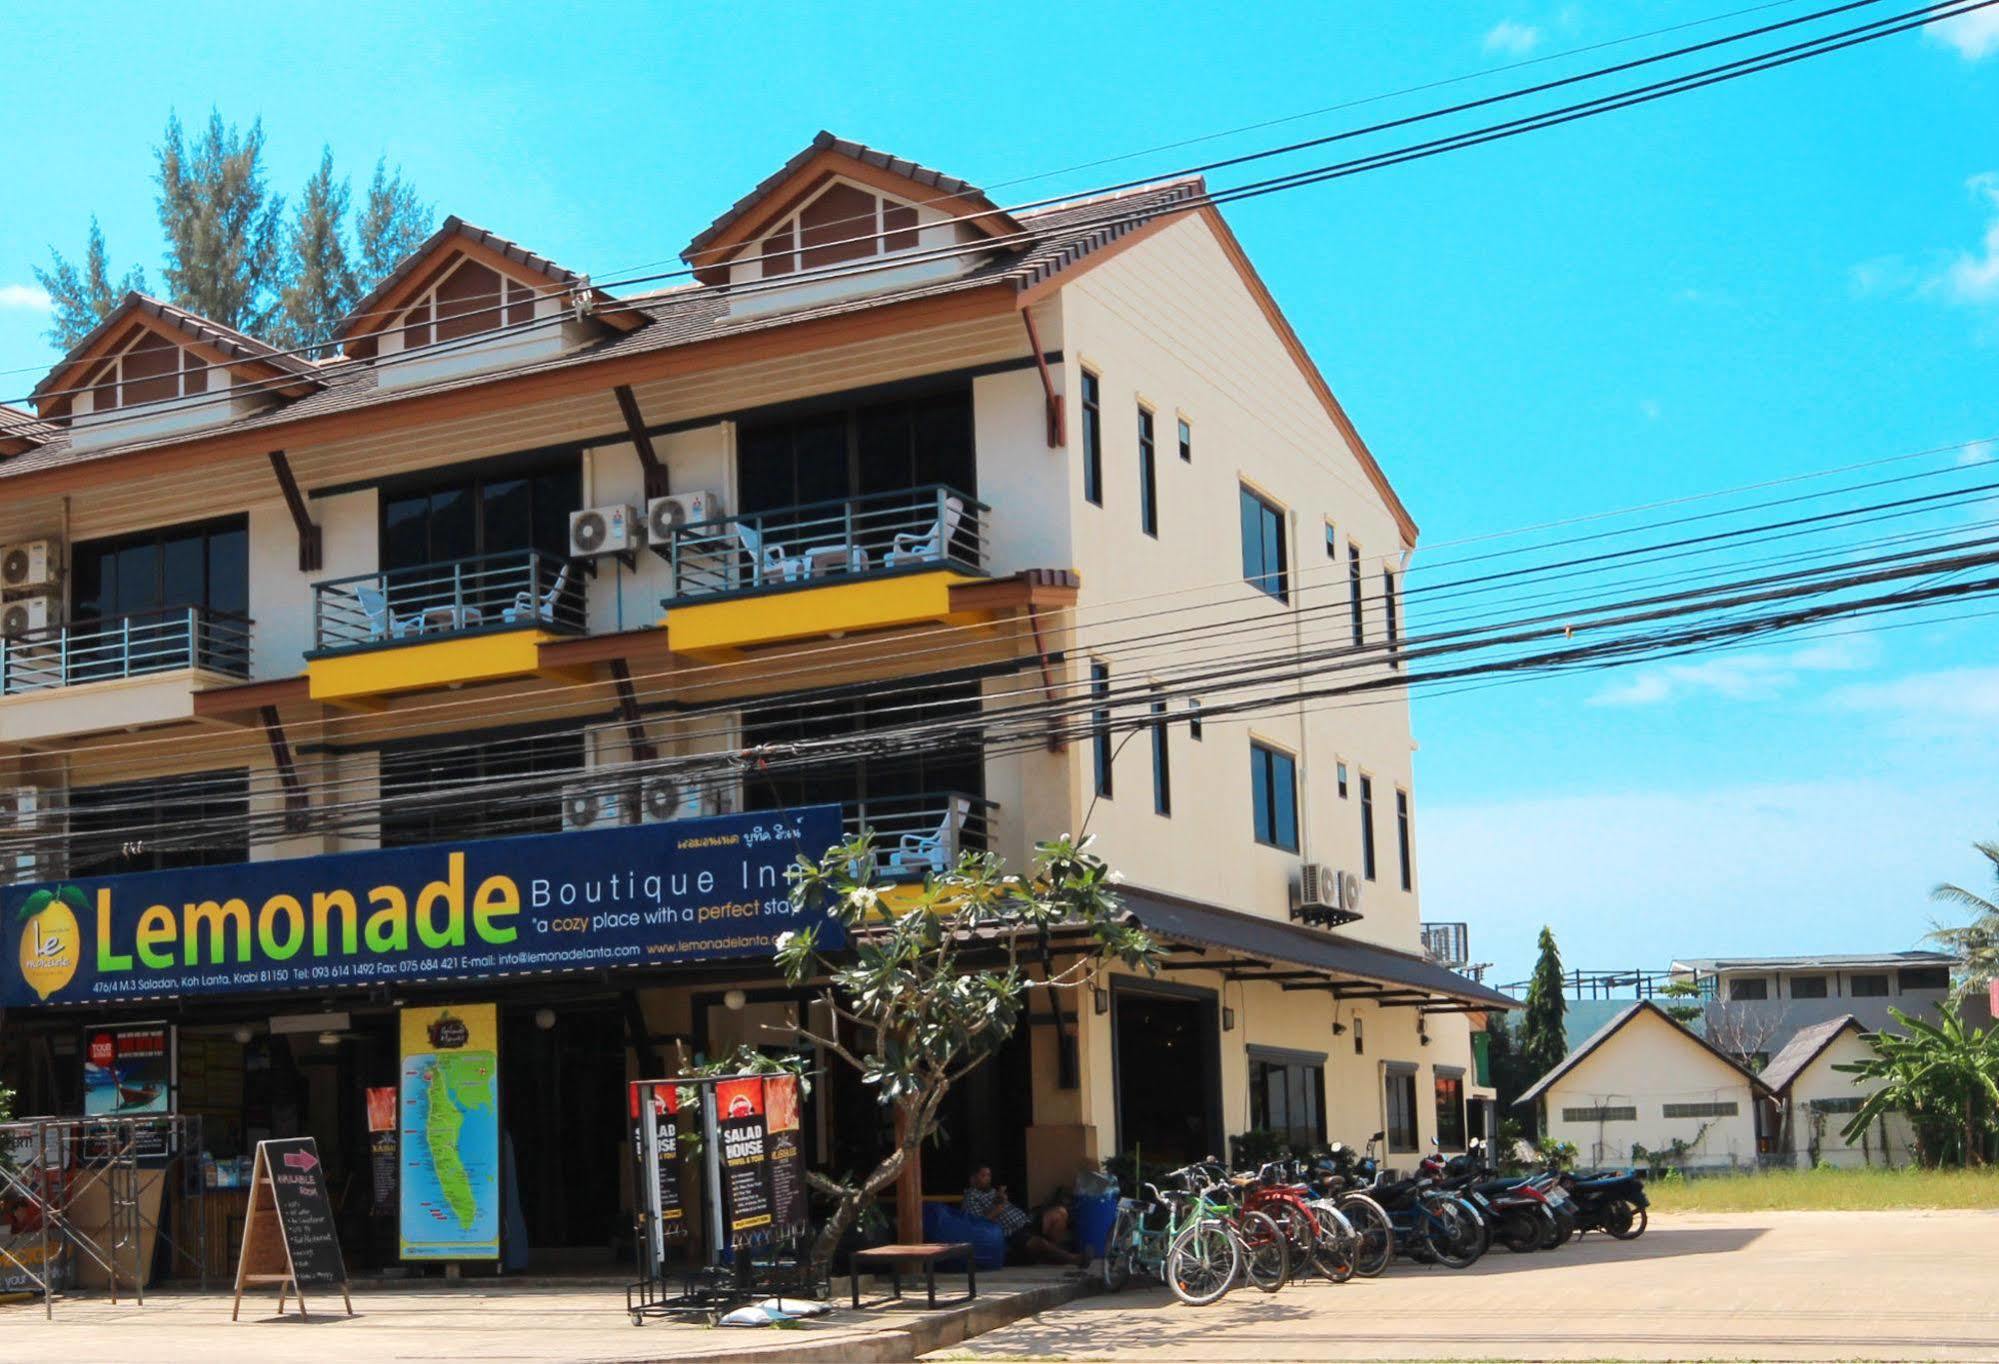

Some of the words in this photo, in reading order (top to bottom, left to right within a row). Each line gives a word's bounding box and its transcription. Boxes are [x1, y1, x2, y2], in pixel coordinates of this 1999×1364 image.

[532, 871, 714, 907] Boutique
[742, 861, 803, 890] Inn
[97, 852, 521, 972] Lemonade
[551, 916, 589, 933] cozy
[593, 911, 640, 932] place
[643, 905, 678, 925] with
[681, 907, 694, 922] a
[698, 899, 761, 923] perfect
[93, 981, 118, 994] 476/4
[119, 979, 136, 991] M.3
[181, 975, 200, 988] Koh
[233, 972, 259, 985] Krabi
[260, 969, 289, 982] 81150
[293, 967, 309, 980] Tel:
[312, 966, 329, 978] 093
[331, 965, 350, 977] 614
[353, 963, 375, 976] 1492
[377, 962, 397, 974] Fax:
[400, 960, 418, 972] 075
[420, 958, 439, 970] 684
[440, 956, 458, 969] 421
[462, 955, 495, 968] E-mail:
[499, 945, 641, 964] info@lemonadelanta.com
[646, 935, 780, 954] www.lemonadelanta.c
[723, 1125, 763, 1143] SALAD
[726, 1140, 764, 1159] HOUSE
